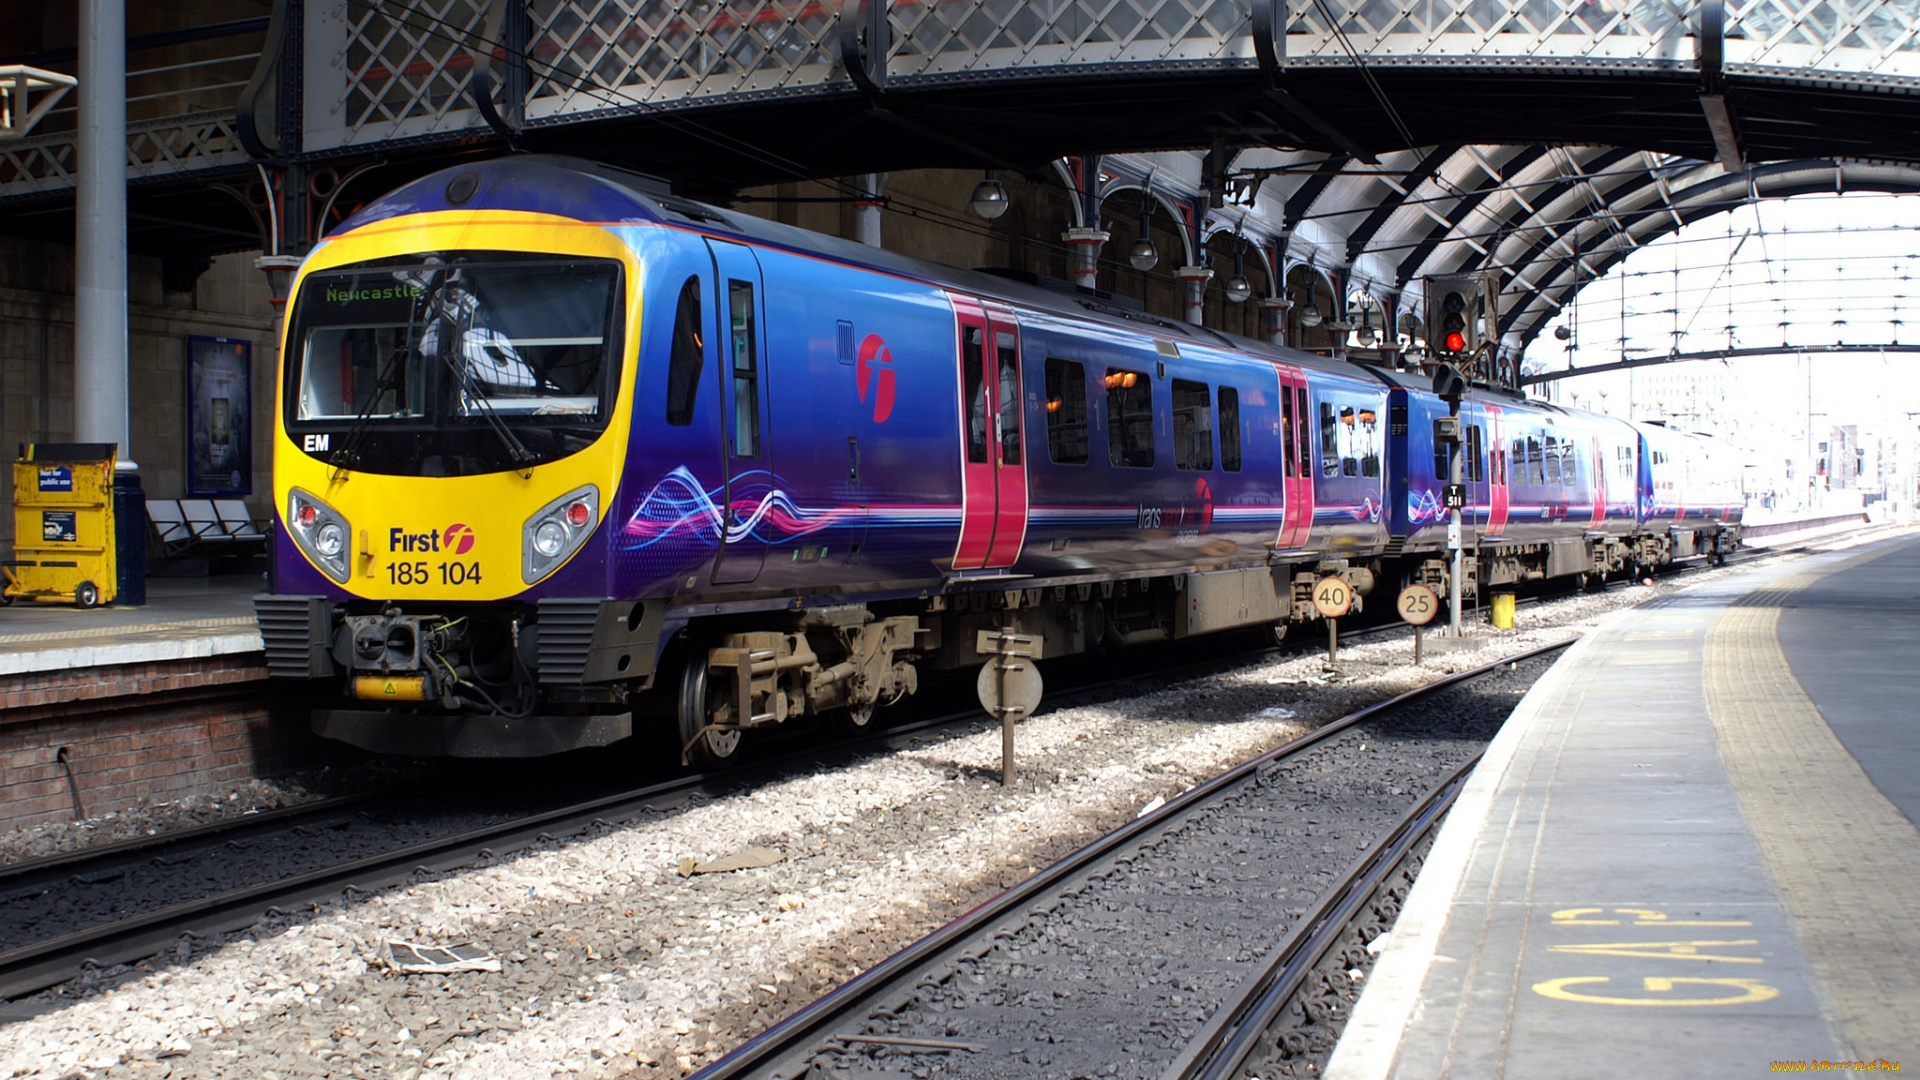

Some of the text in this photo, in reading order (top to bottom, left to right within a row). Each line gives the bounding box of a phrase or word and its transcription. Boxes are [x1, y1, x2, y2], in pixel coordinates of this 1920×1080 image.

[326, 284, 420, 302] Newcastle
[304, 434, 330, 452] EM
[1451, 486, 1458, 495] T
[1448, 496, 1462, 507] 511
[390, 528, 440, 552] First
[386, 562, 482, 585] 185 104
[1319, 588, 1344, 606] 40
[1406, 595, 1429, 613] 25
[1531, 907, 1781, 1007] GAP
